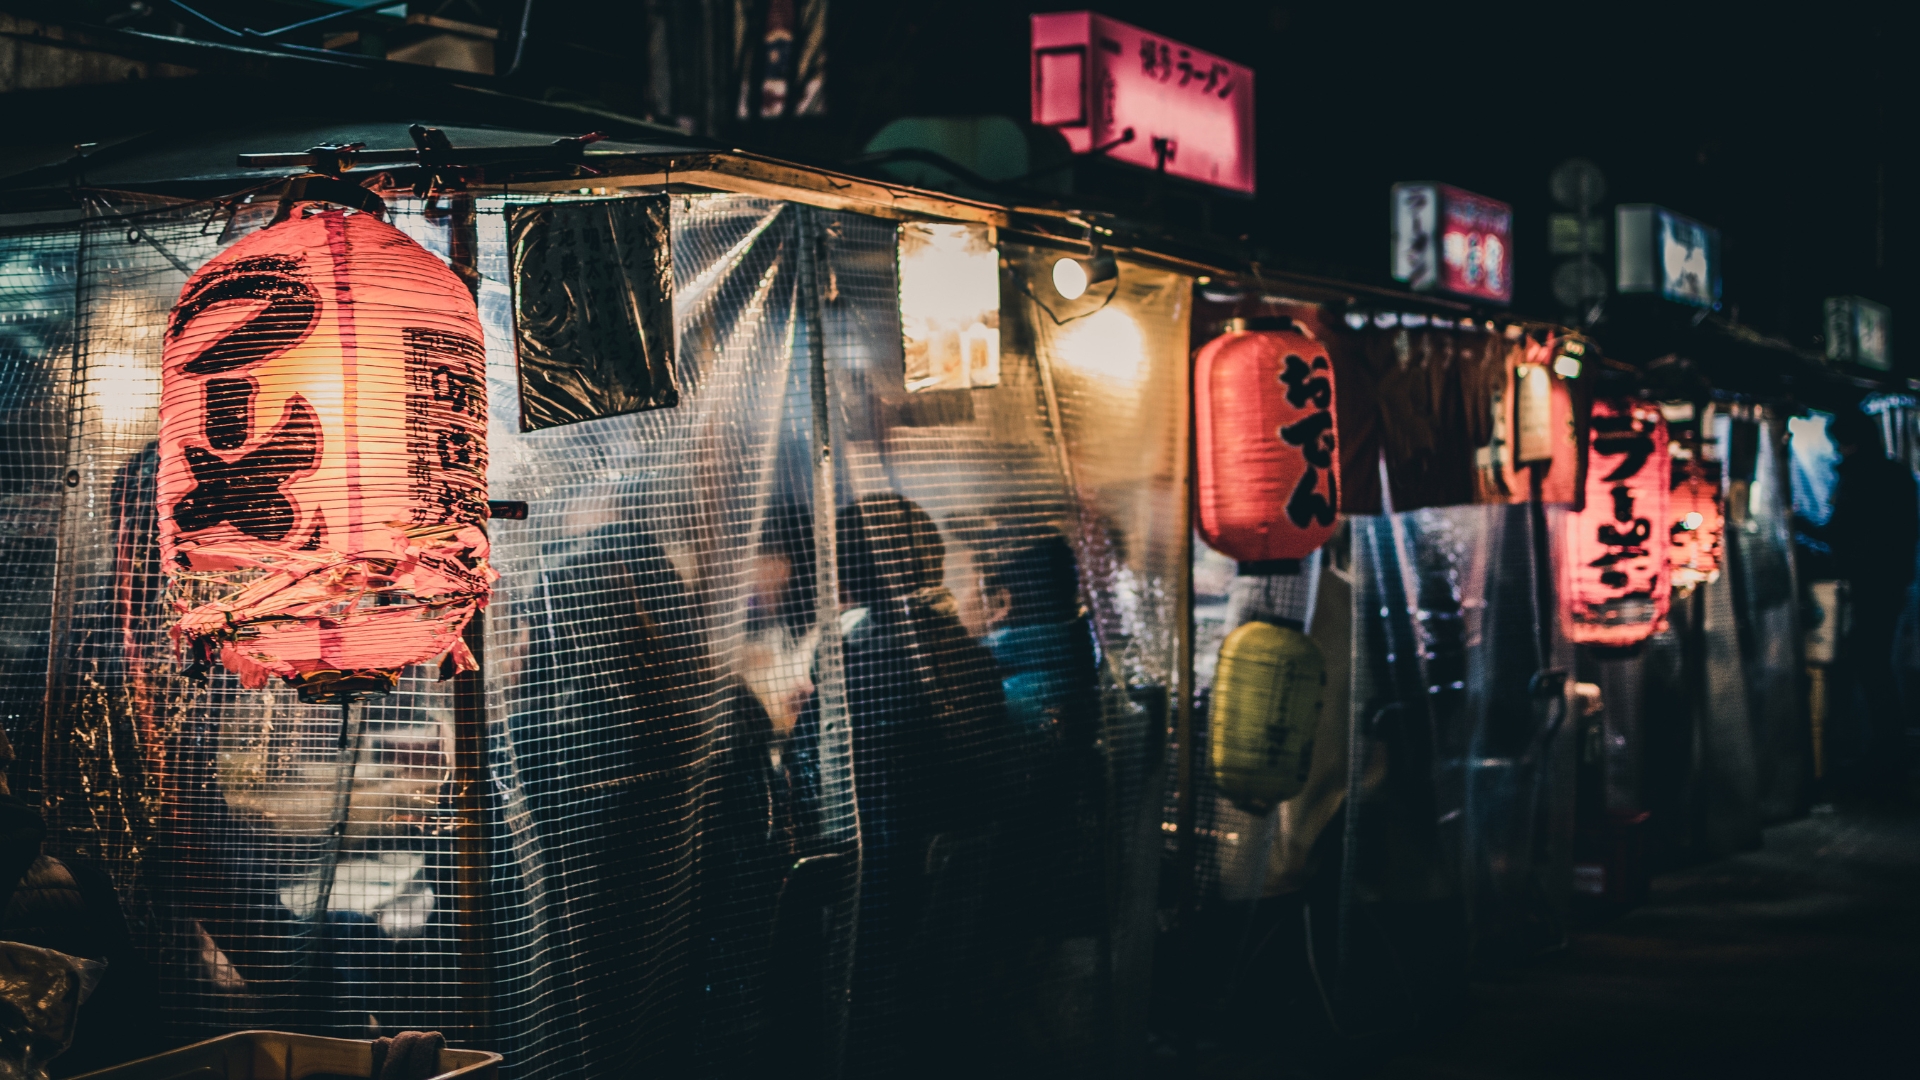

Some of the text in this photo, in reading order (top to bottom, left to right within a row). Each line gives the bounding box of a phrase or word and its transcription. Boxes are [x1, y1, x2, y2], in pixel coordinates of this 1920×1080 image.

[171, 254, 330, 550] ラーメ
[1278, 354, 1337, 529] おでん
